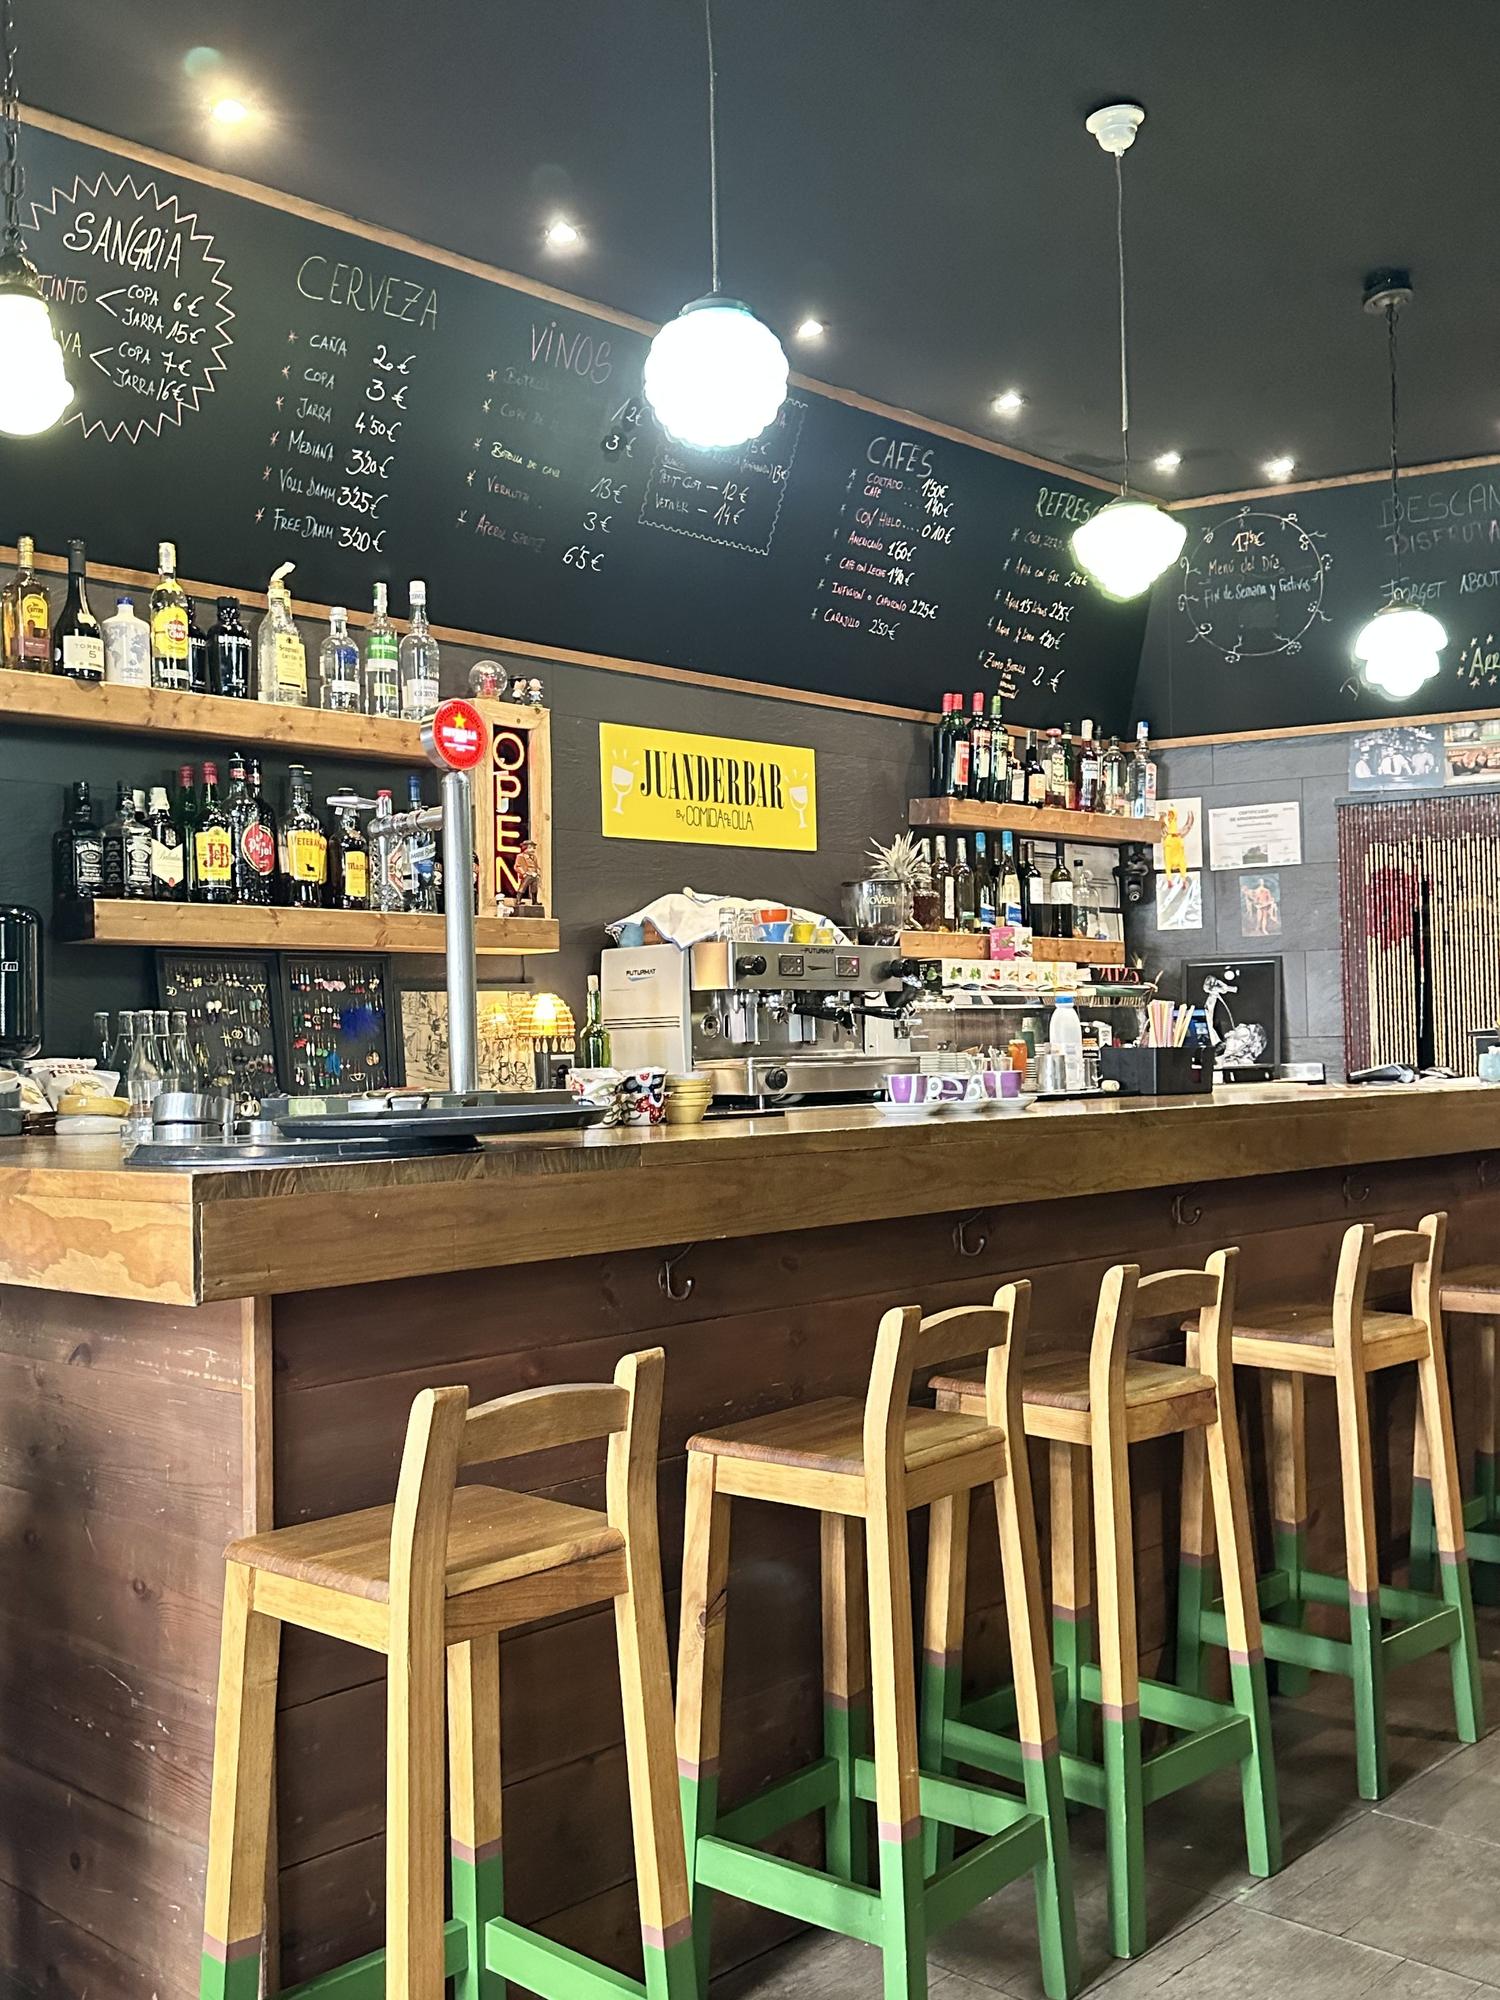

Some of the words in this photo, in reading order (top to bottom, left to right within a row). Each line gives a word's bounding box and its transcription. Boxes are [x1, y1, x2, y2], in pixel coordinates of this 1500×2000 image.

[127, 285, 160, 306] COPA
[297, 255, 438, 331] CERVEZA
[122, 306, 164, 334] JARRA
[166, 320, 207, 345] 15€
[118, 341, 151, 364] COPA
[161, 352, 192, 377] 7€
[309, 333, 348, 357] CAÑA
[113, 366, 155, 395] JARRA
[304, 367, 336, 390] COPA
[297, 398, 333, 424] JARRA
[288, 430, 334, 463] MEDIANA
[279, 466, 303, 495] VOLL
[273, 508, 302, 533] FREE
[1208, 559, 1235, 577] Menú
[1240, 555, 1255, 574] del
[1262, 553, 1280, 572] Día
[1223, 584, 1234, 600] de
[1235, 583, 1267, 600] Semana
[1269, 583, 1276, 601] y
[640, 748, 785, 810] JUANDERBAR
[492, 732, 525, 893] OPEN
